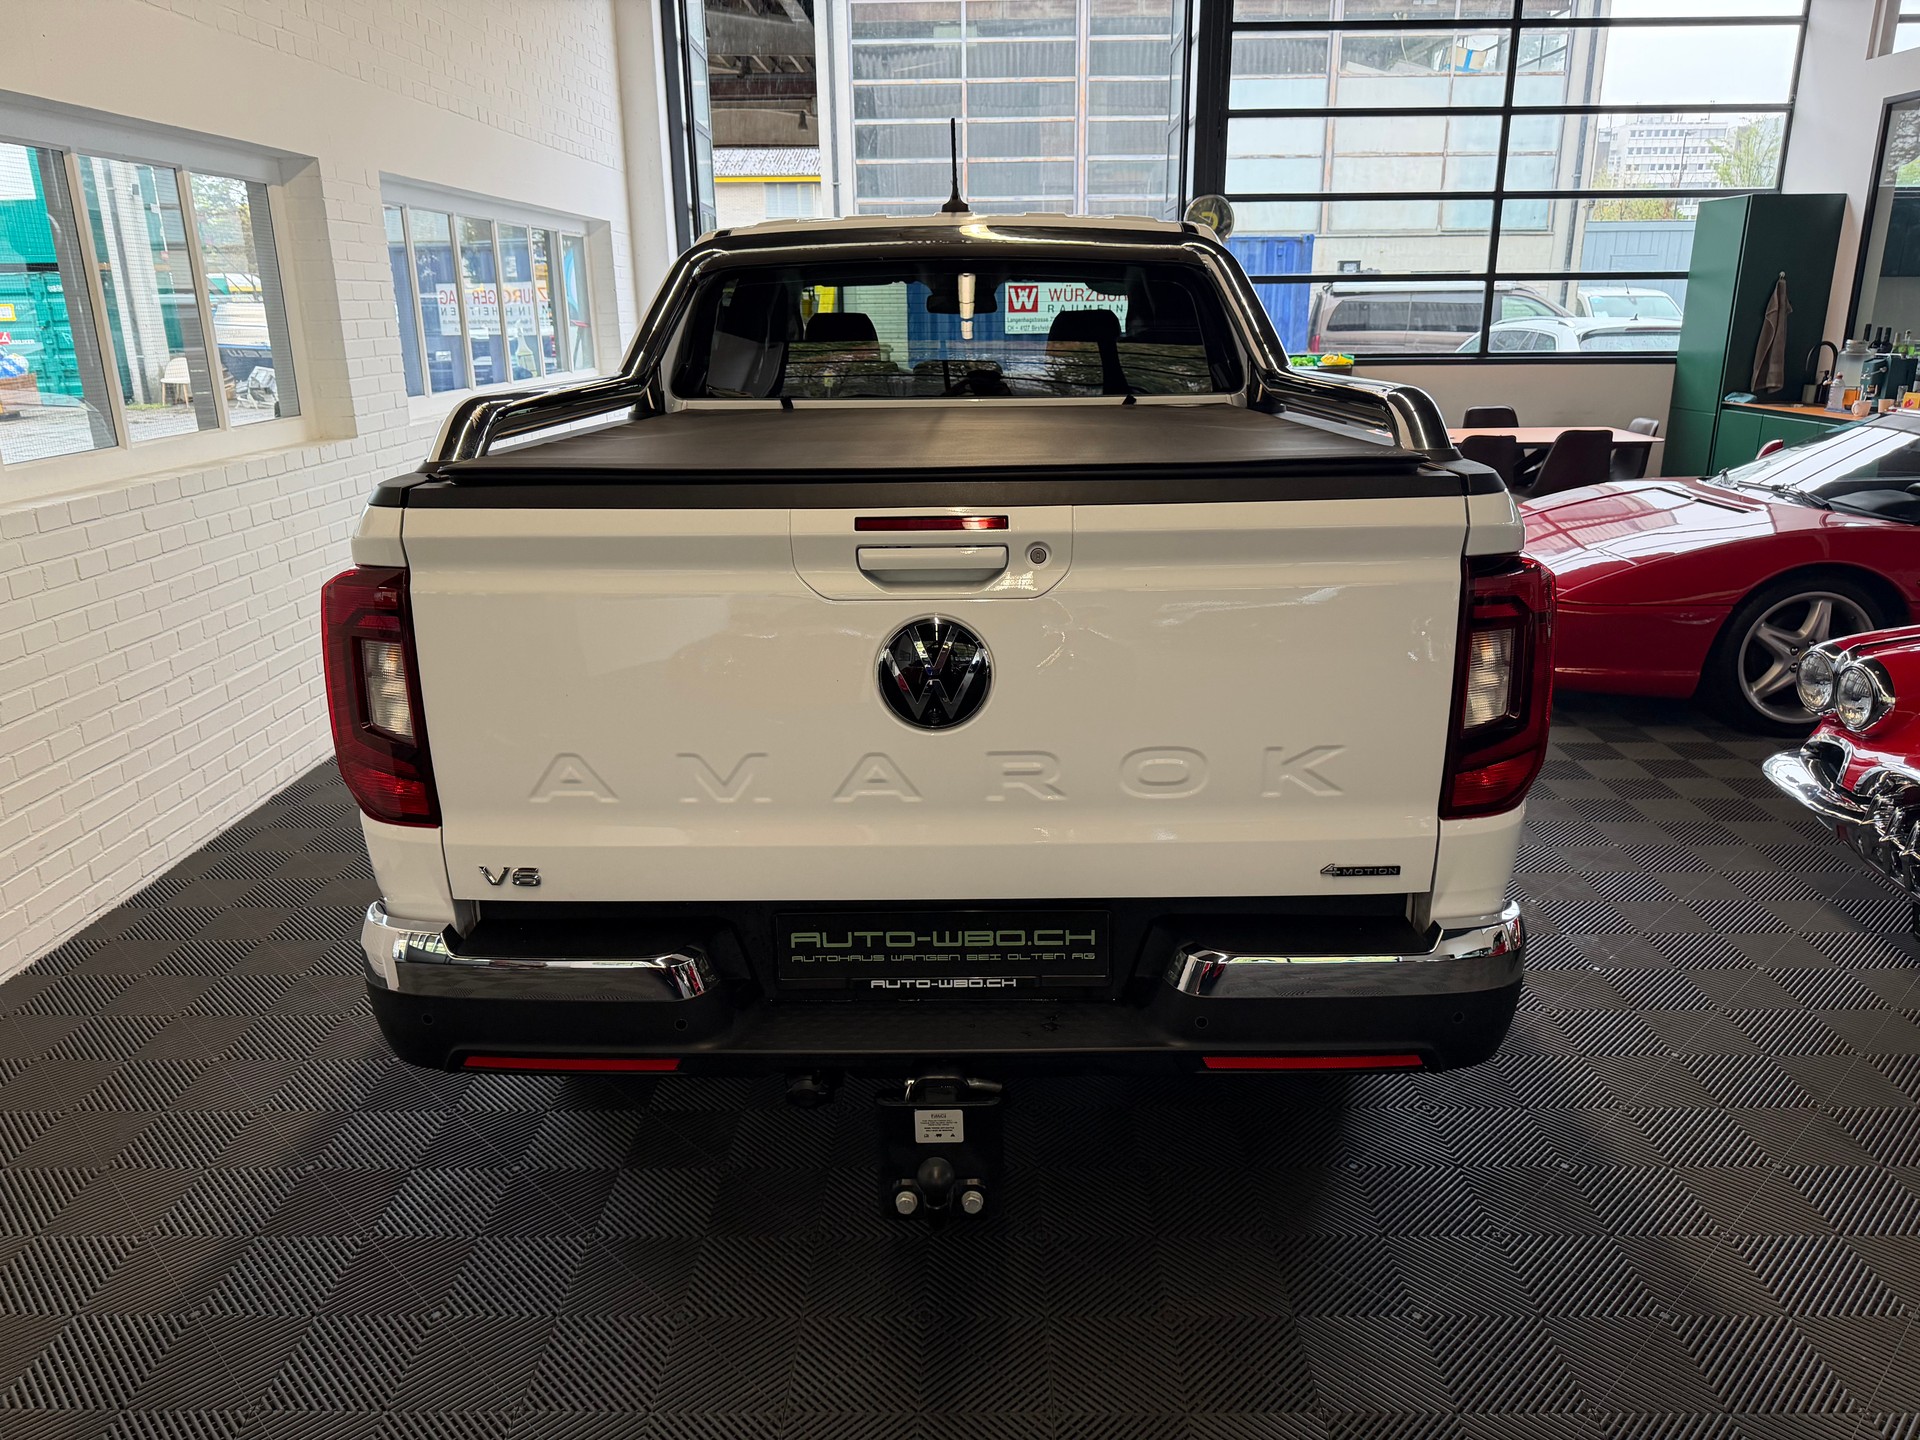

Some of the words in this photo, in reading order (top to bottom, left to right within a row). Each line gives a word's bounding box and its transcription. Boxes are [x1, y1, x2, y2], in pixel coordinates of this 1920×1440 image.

[528, 744, 1347, 804] AMAROK
[478, 866, 541, 887] V6
[1320, 863, 1400, 877] 4MOTION
[790, 929, 1096, 949] AUTO-WBO.CH
[791, 953, 885, 963] AUTOHAUS
[890, 953, 961, 962] WANGEN
[966, 953, 1002, 961] BEI
[1007, 952, 1067, 961] OLTEN
[1071, 952, 1096, 960] AG
[870, 978, 1017, 989] AUTO-WBO.CH
